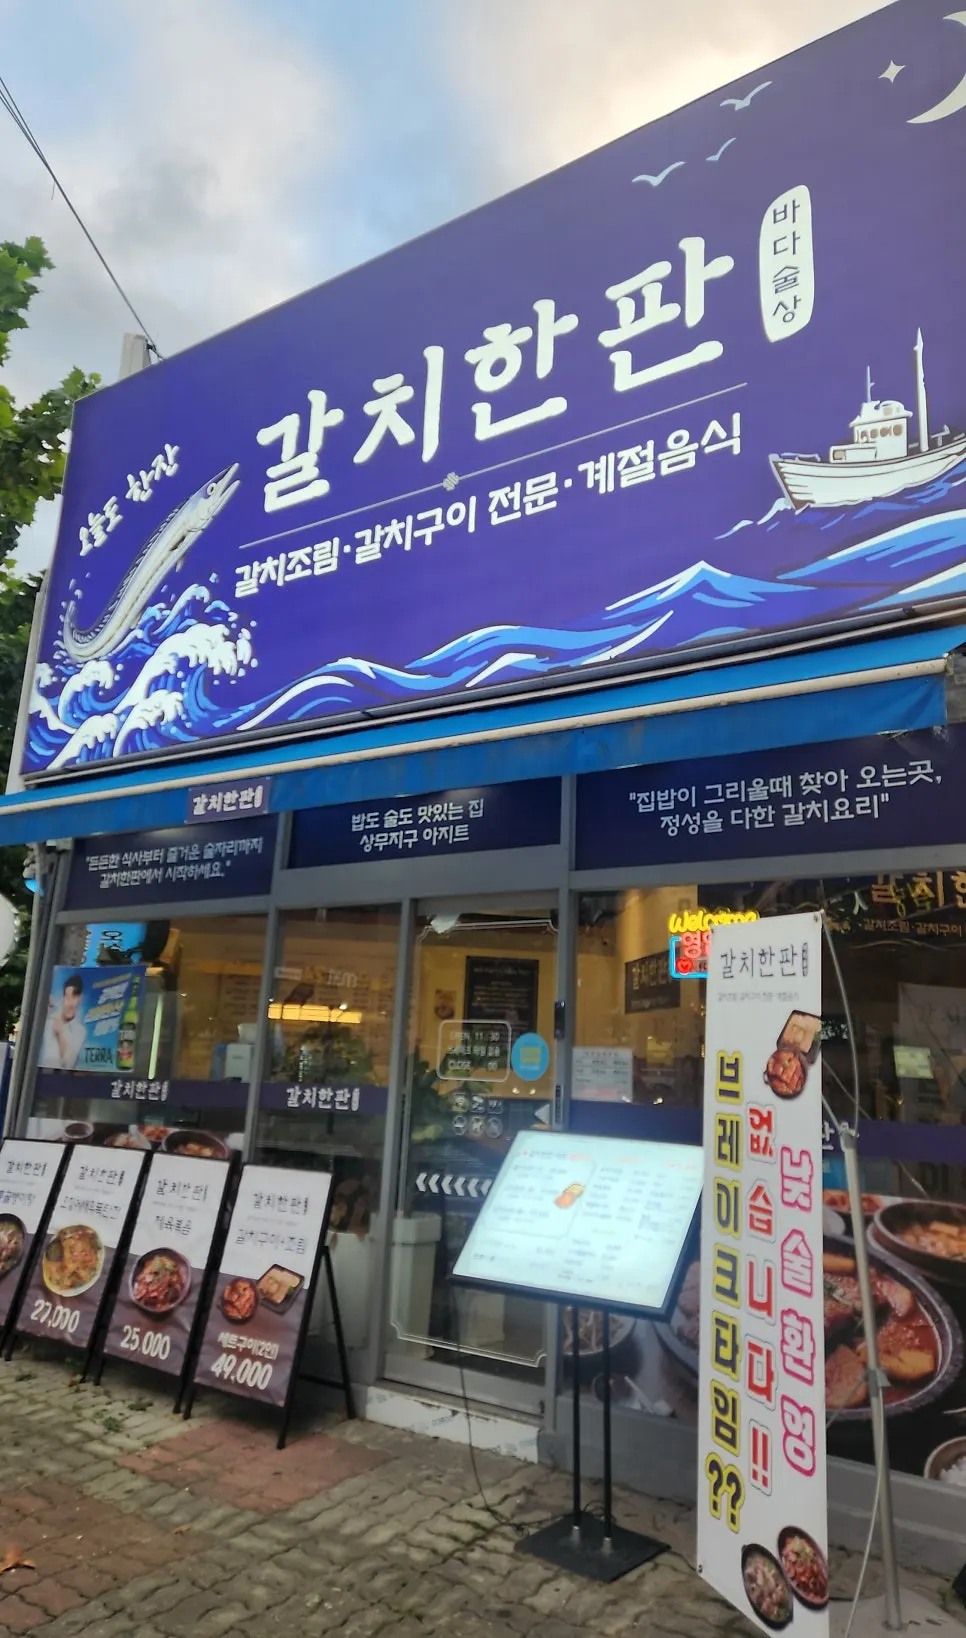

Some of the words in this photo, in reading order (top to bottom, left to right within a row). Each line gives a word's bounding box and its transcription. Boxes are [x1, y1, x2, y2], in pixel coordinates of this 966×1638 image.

[772, 198, 802, 323] 바다술상
[256, 235, 736, 513] 갈치한판
[79, 495, 123, 557] 오늘도
[125, 443, 180, 503] 한잔
[192, 786, 255, 817] 갈치한판
[629, 785, 697, 814] "집밥이
[703, 772, 793, 805] 그리울때
[799, 767, 849, 795] 찾아
[856, 758, 942, 790] 오는곳,
[351, 812, 380, 832] 밥도
[383, 807, 413, 828] 술도
[418, 801, 464, 825] 맛있는
[468, 798, 485, 819] 집
[660, 809, 724, 838] 정성을
[730, 803, 776, 831] 다한
[783, 793, 890, 827] 갈치요리"
[359, 830, 419, 853] 상무지구
[422, 824, 470, 846] 아지트
[121, 847, 164, 868] 식사부터
[166, 843, 201, 864] 즐거운
[99, 866, 163, 889] 갈치한판에서
[720, 944, 798, 980] 갈치한판
[84, 1047, 114, 1065] TERRA
[110, 1080, 162, 1101] 갈치한판
[286, 1086, 351, 1111] 갈치한판
